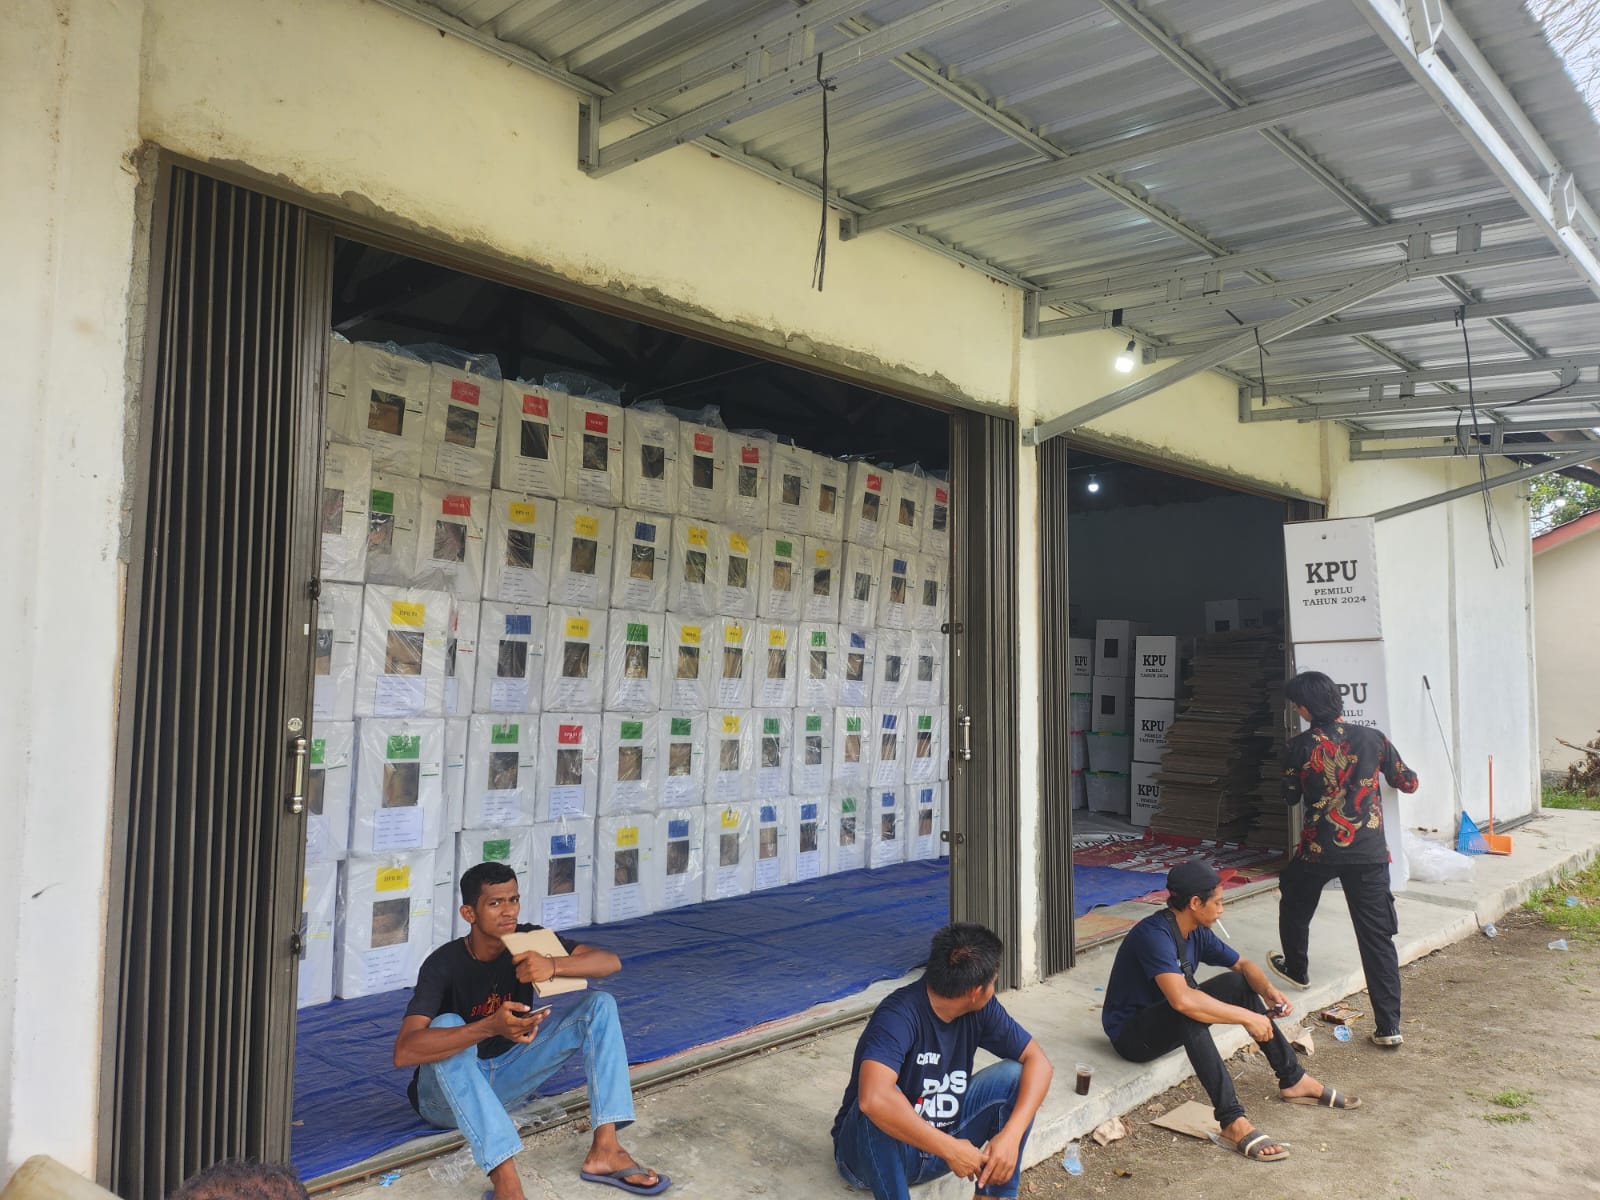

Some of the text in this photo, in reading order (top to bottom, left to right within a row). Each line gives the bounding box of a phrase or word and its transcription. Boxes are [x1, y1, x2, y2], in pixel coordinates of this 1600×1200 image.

[1305, 559, 1357, 584] KPU
[1314, 586, 1353, 596] PEMILU
[1302, 595, 1367, 607] TAHUN 2024
[1074, 655, 1088, 666] KPU
[1143, 654, 1167, 666] KPU
[1141, 719, 1165, 732] KPU
[1137, 783, 1160, 797] KPU
